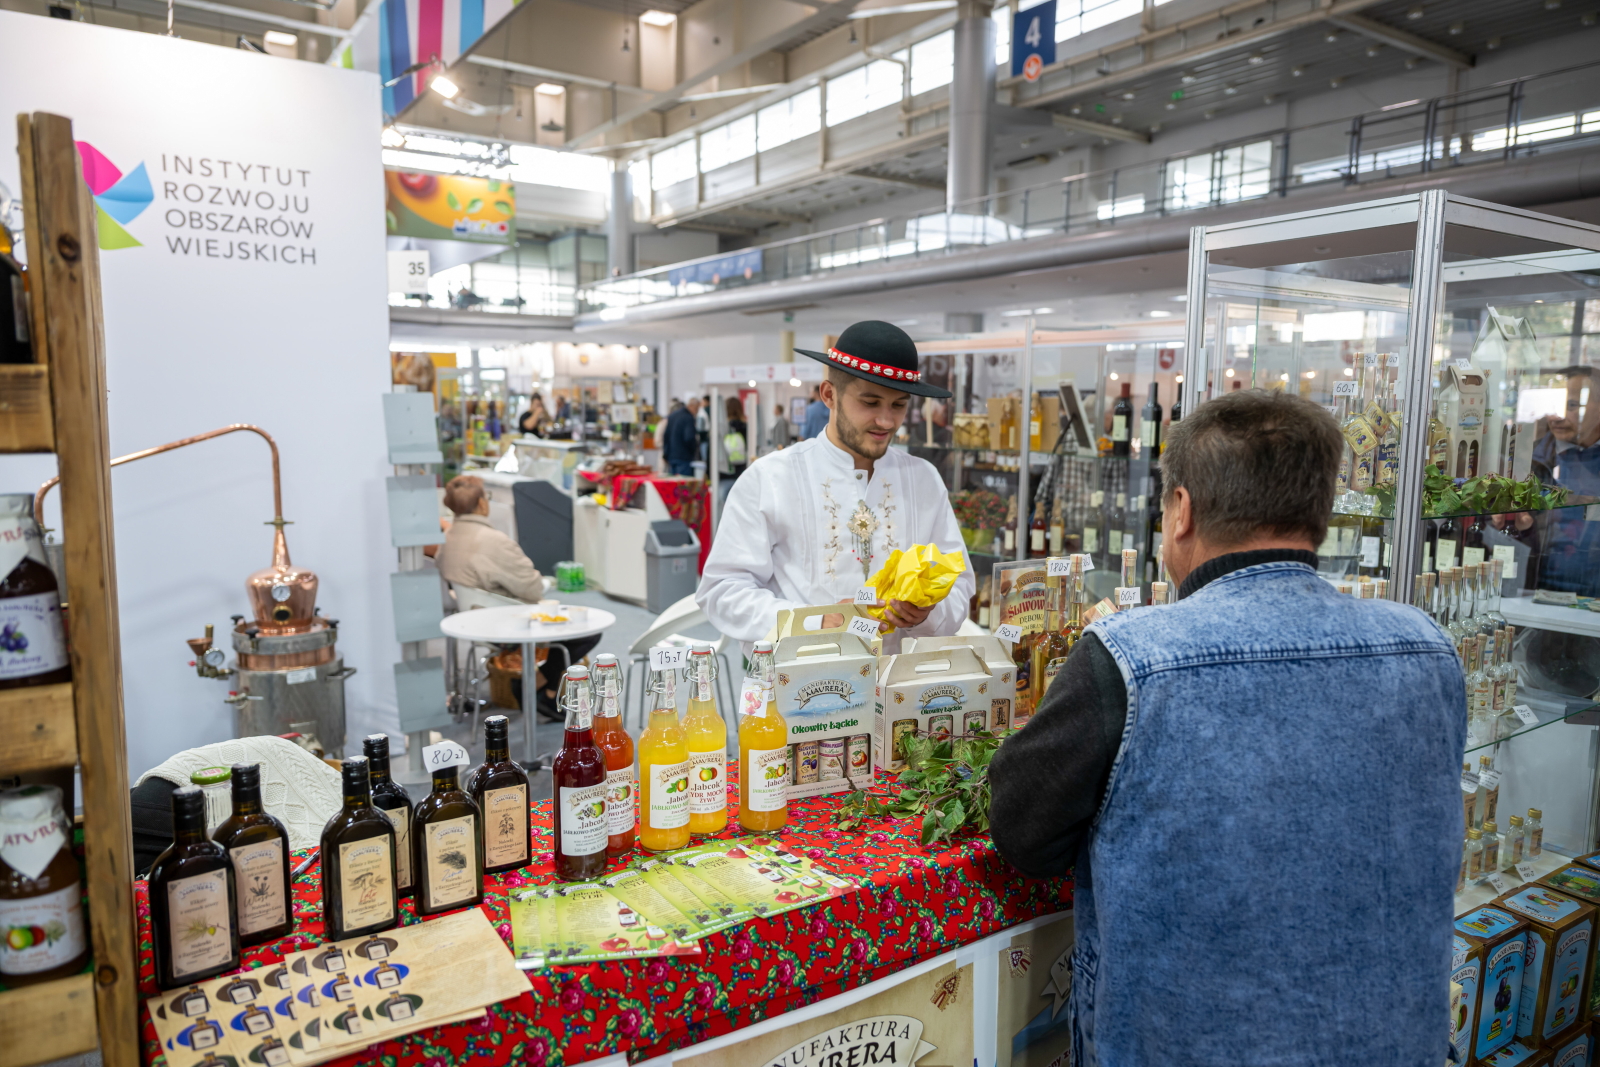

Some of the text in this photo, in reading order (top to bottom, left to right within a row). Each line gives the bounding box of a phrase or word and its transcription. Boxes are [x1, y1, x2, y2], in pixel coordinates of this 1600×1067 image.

[1024, 16, 1042, 48] 4
[162, 153, 311, 187] INSTYTUT
[164, 181, 309, 214] ROZWOJU
[165, 208, 313, 239] OBSZARÓW
[166, 235, 316, 265] WIEJSKICH
[408, 262, 425, 275] 35
[1008, 599, 1045, 619] ŚLIWOW
[1019, 613, 1044, 625] DĘBOW
[801, 680, 848, 694] MANUFAKTURA
[791, 718, 859, 734] Okowity Łąckie
[4, 821, 59, 846] ATURA
[772, 1020, 911, 1067] NUFAKTURA
